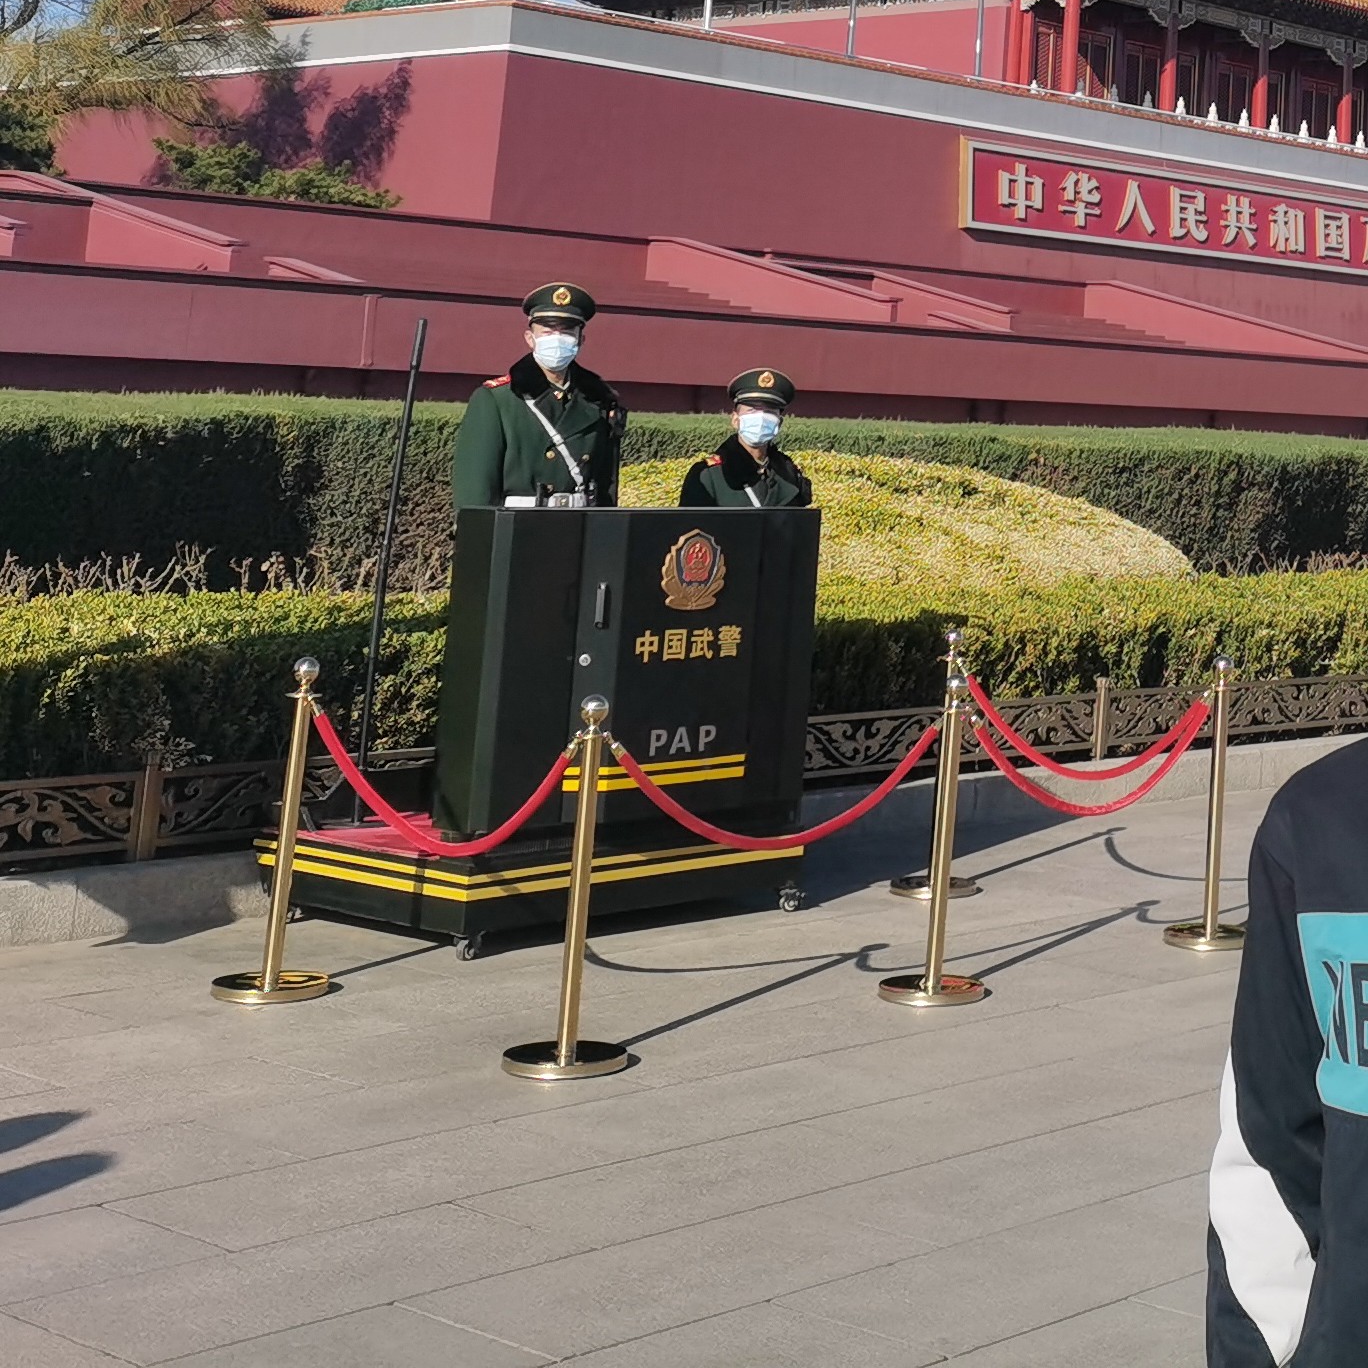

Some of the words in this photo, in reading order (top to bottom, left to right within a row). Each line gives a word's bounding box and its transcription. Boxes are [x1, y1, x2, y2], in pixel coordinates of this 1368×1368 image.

[634, 625, 742, 663] 中国武警
[648, 725, 717, 757] PAP
